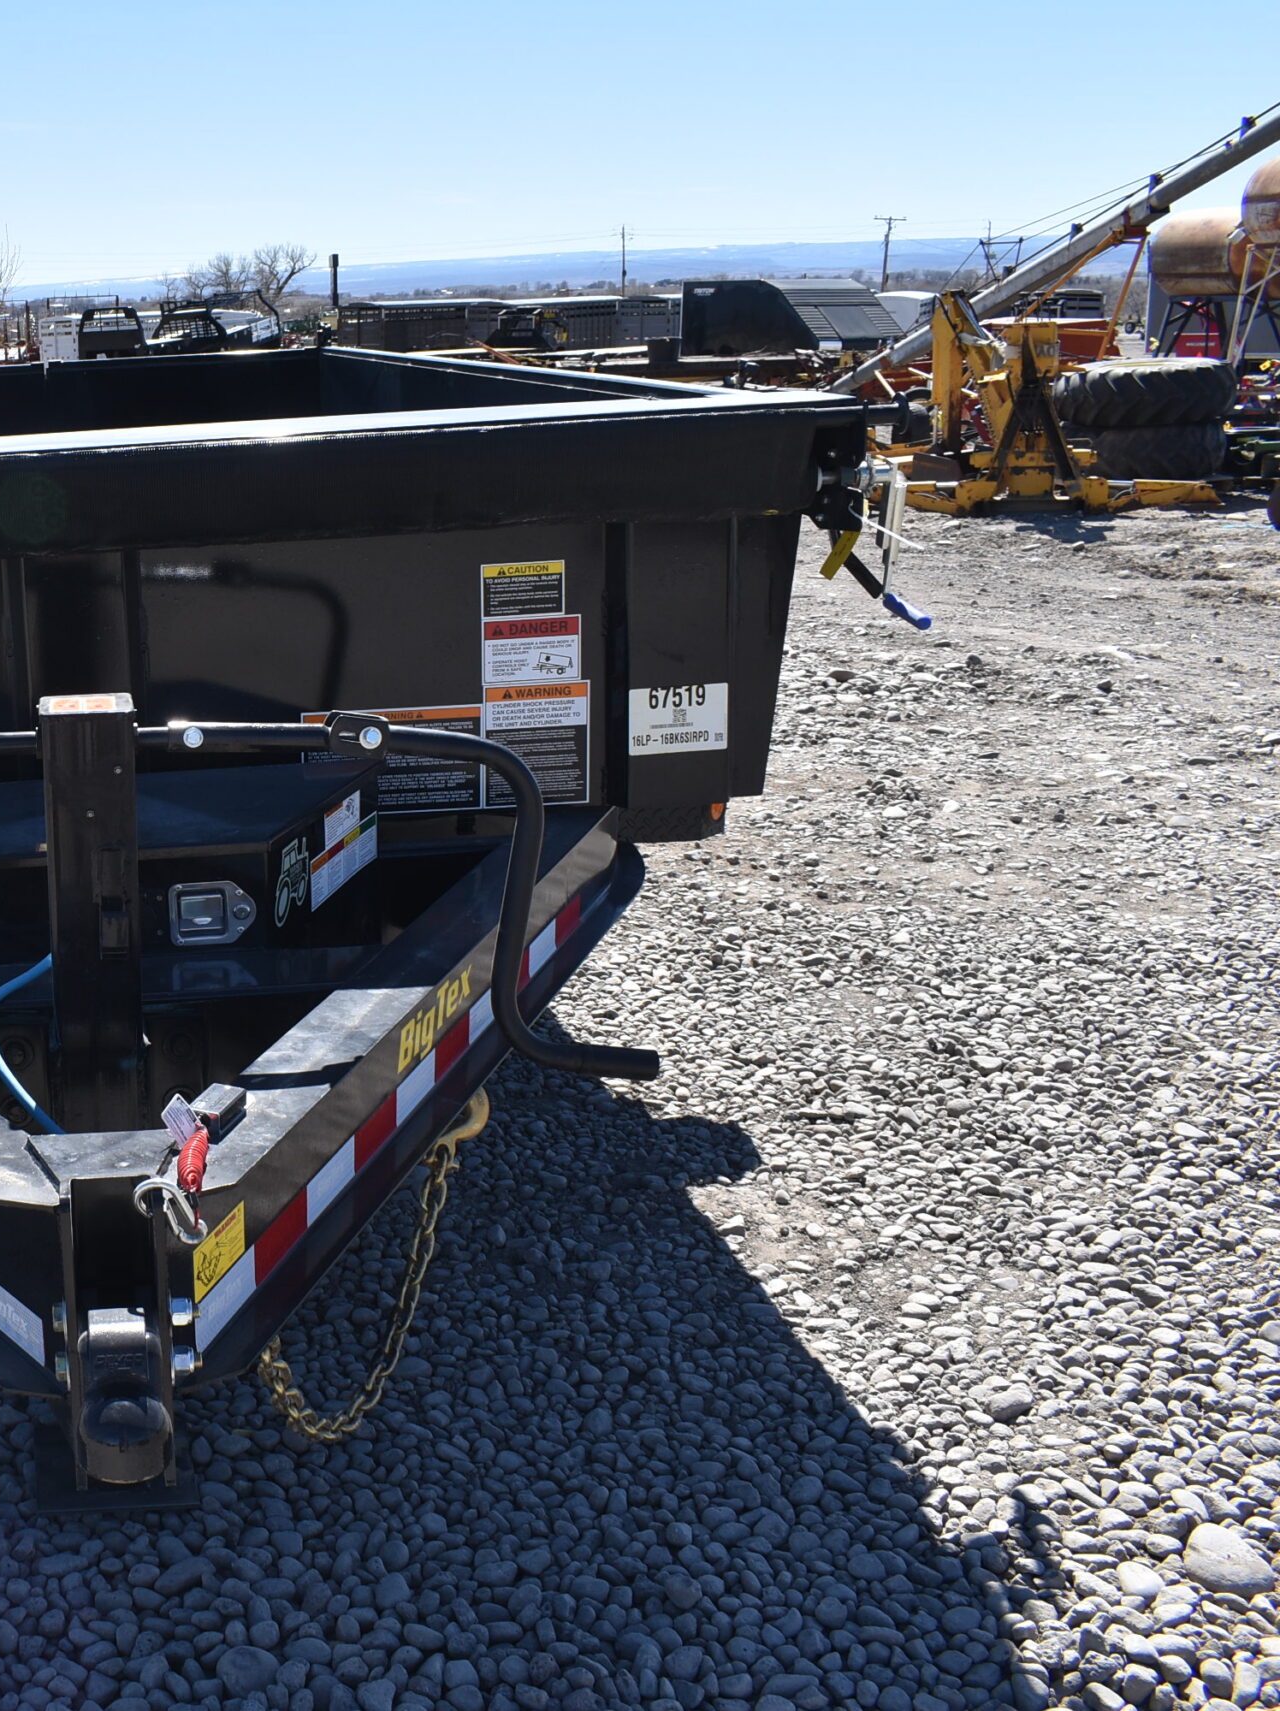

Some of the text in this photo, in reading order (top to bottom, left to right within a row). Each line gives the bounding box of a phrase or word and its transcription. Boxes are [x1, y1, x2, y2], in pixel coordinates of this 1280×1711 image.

[507, 565, 549, 575] CAUTION
[509, 621, 568, 635] DANGER
[515, 686, 571, 698] WARNING
[649, 684, 706, 709] 67519
[398, 964, 472, 1074] BigTex
